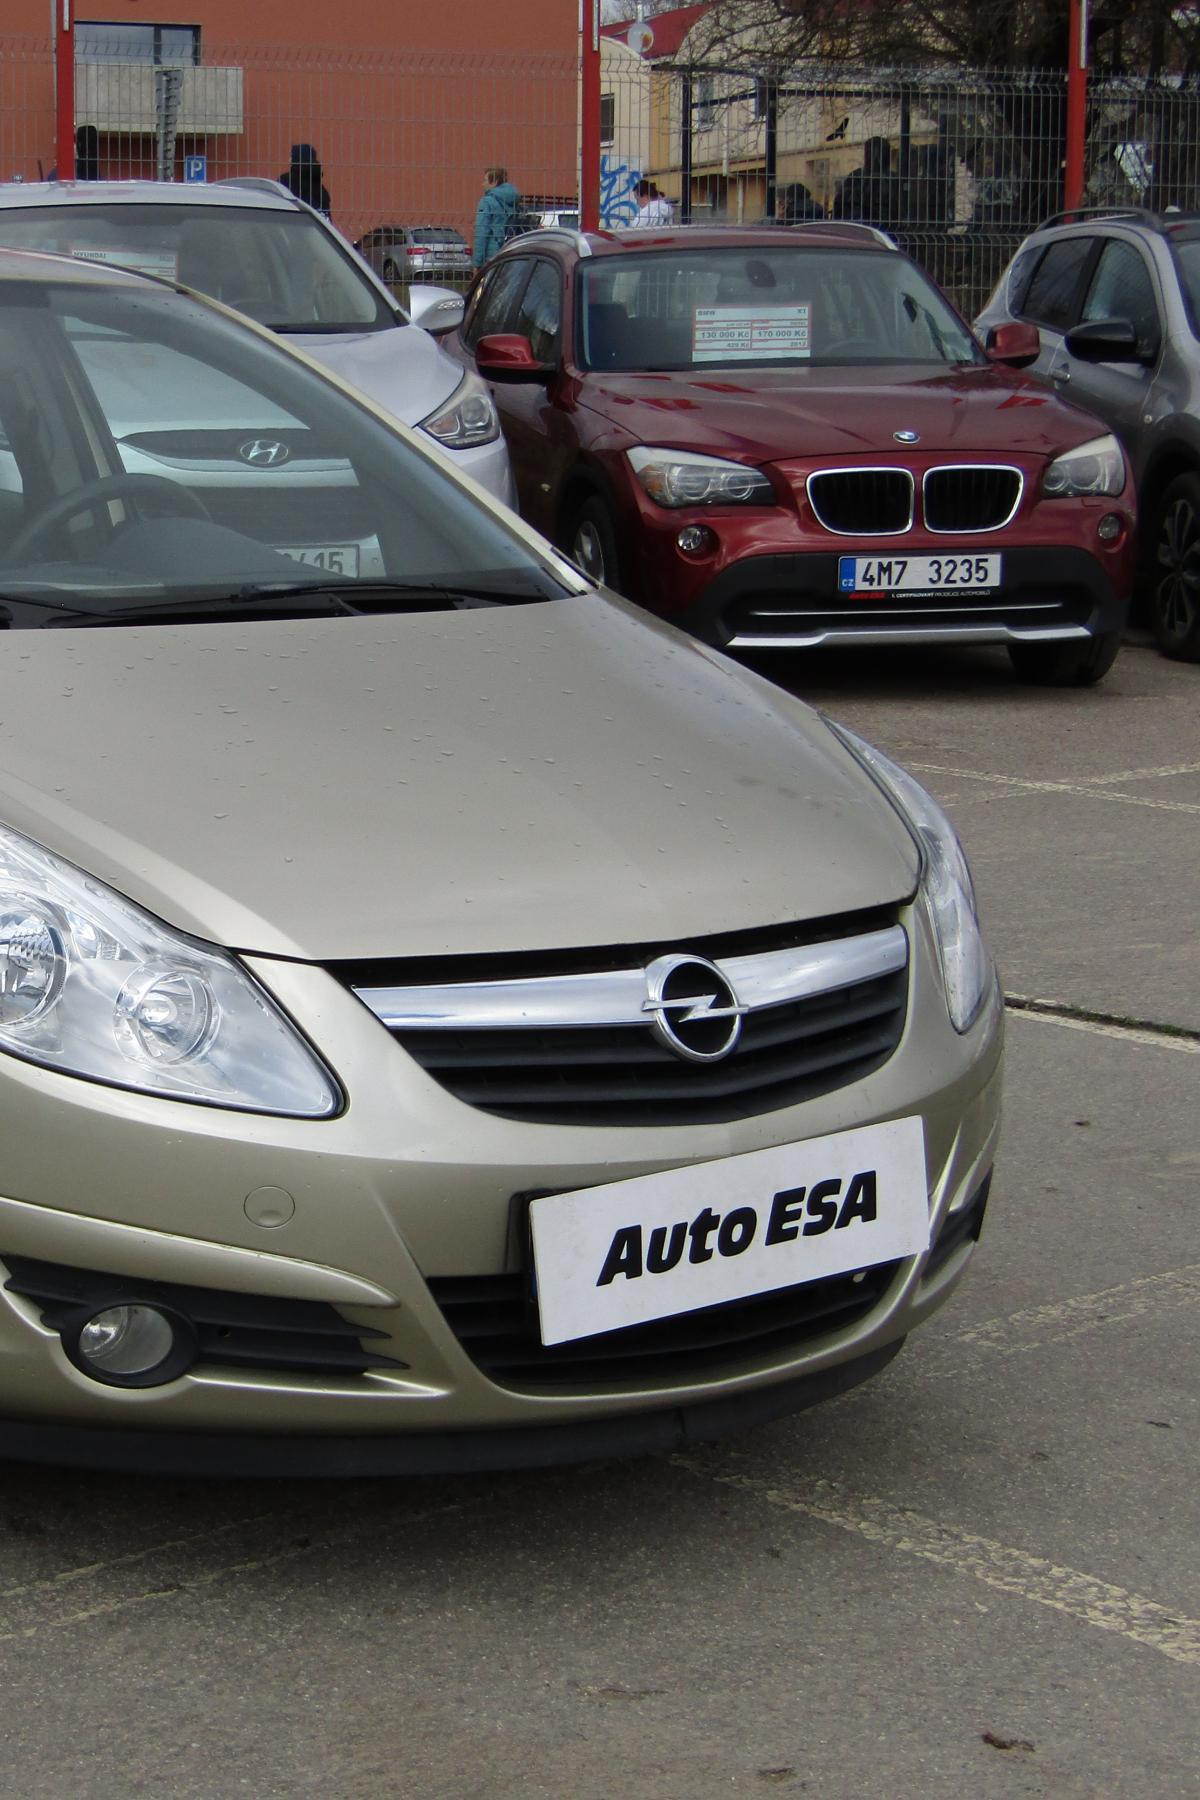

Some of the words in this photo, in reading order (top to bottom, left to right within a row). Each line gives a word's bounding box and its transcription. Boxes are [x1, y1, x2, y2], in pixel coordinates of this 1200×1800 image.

[190, 159, 202, 178] P
[702, 331, 717, 339] 130
[758, 330, 773, 338] 170
[776, 329, 792, 337] 000
[861, 561, 908, 586] 4M7
[928, 557, 989, 585] 3235
[841, 578, 854, 587] CZ
[596, 1206, 757, 1287] Auto
[765, 1169, 877, 1246] ESA
